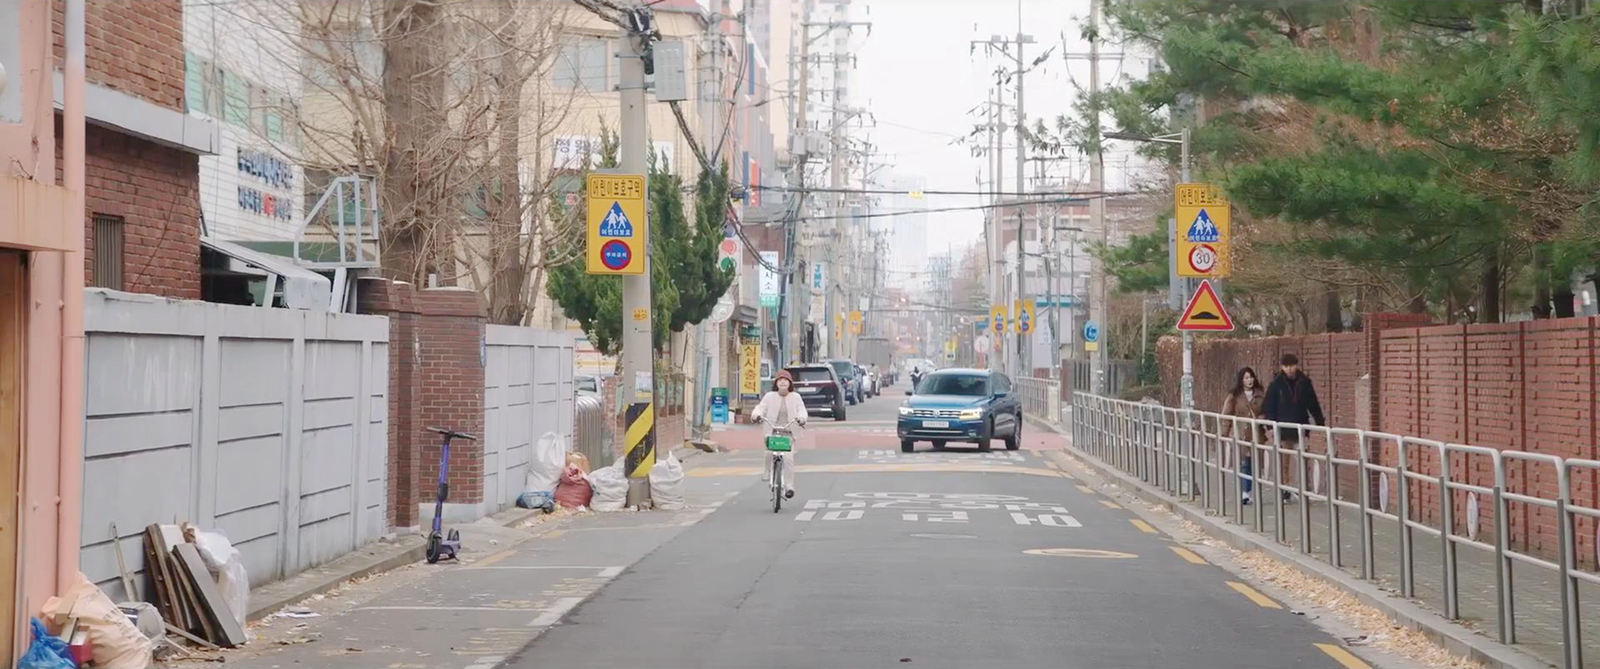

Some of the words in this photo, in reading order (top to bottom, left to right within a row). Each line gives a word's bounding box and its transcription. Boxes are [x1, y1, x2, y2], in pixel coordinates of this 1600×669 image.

[592, 179, 640, 197] 어린이보호구역
[1196, 252, 1210, 265] 30
[744, 346, 757, 392] 실사출력
